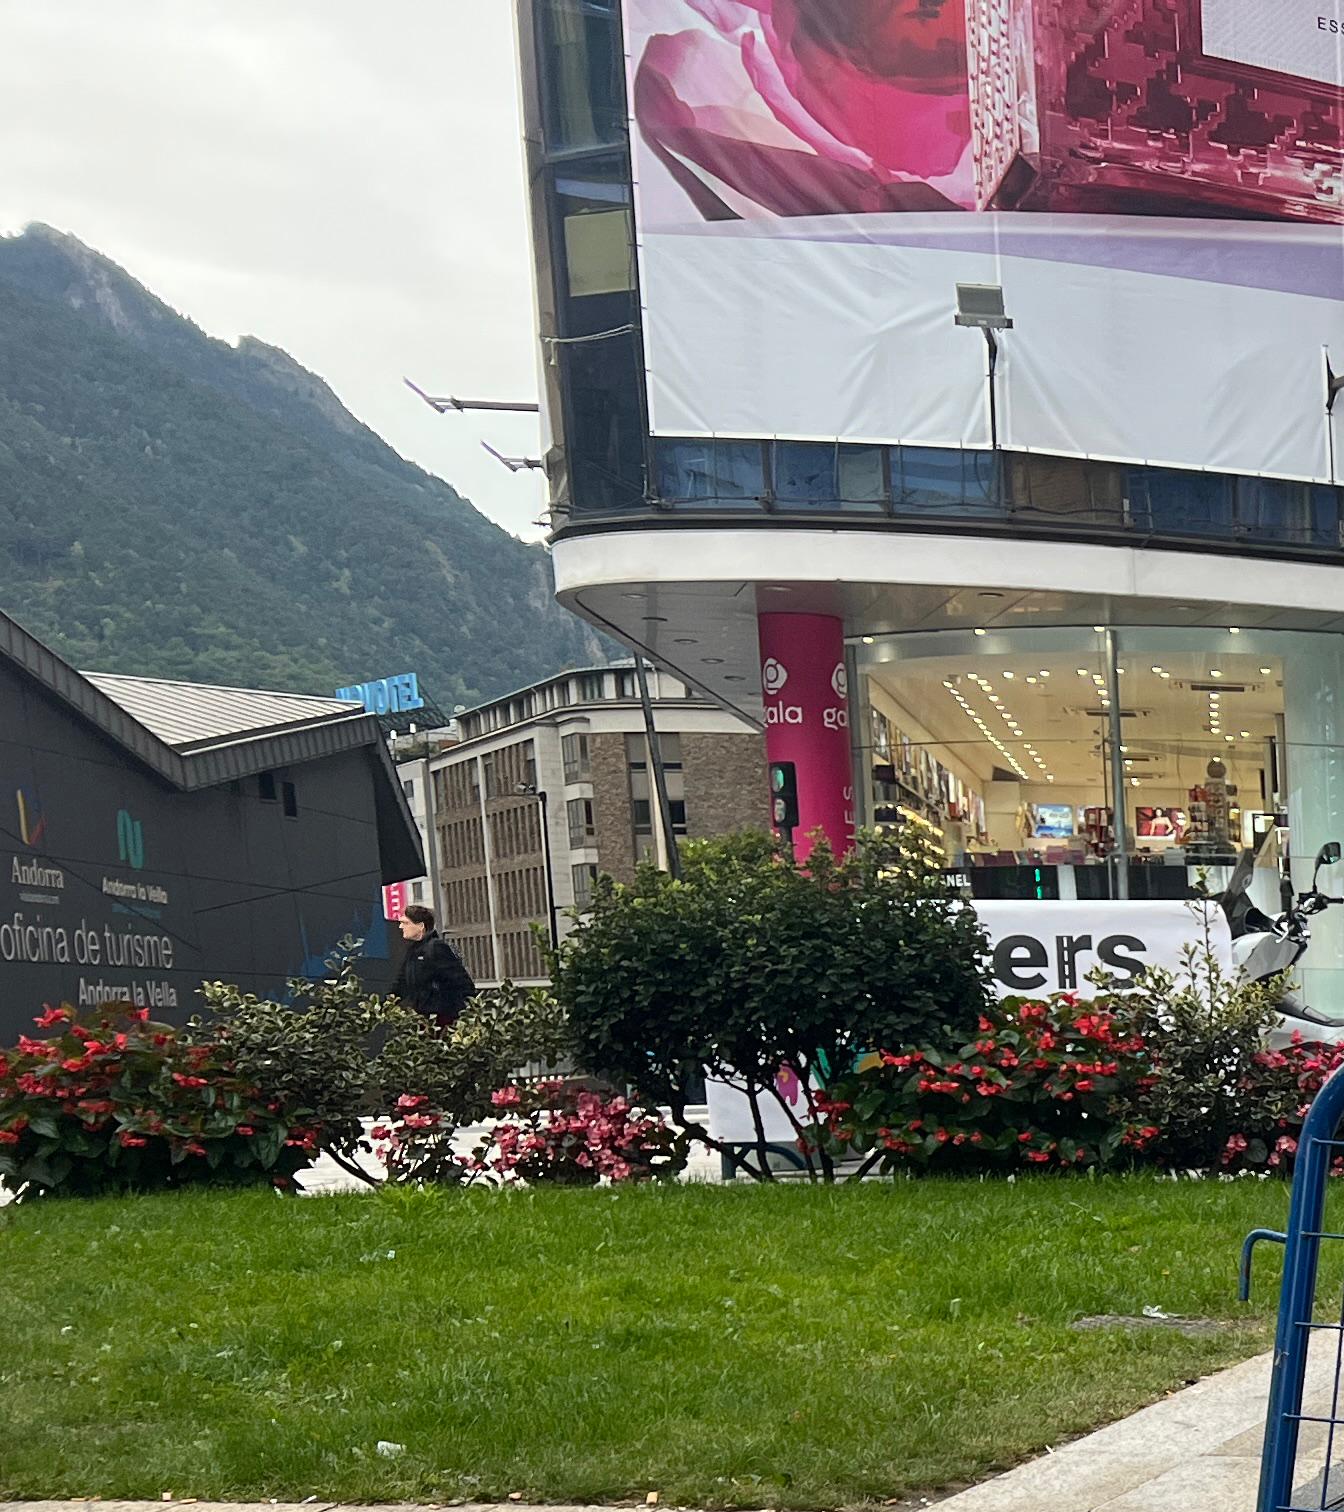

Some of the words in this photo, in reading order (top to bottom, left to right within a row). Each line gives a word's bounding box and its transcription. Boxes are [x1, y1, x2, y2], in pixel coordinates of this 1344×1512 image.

[11, 855, 65, 889] Andorra
[0, 912, 70, 963] oficina
[74, 918, 101, 965] de
[104, 922, 173, 969] turisme
[79, 977, 130, 1005] Andorra
[132, 979, 145, 1006] la
[146, 979, 178, 1007] Vella
